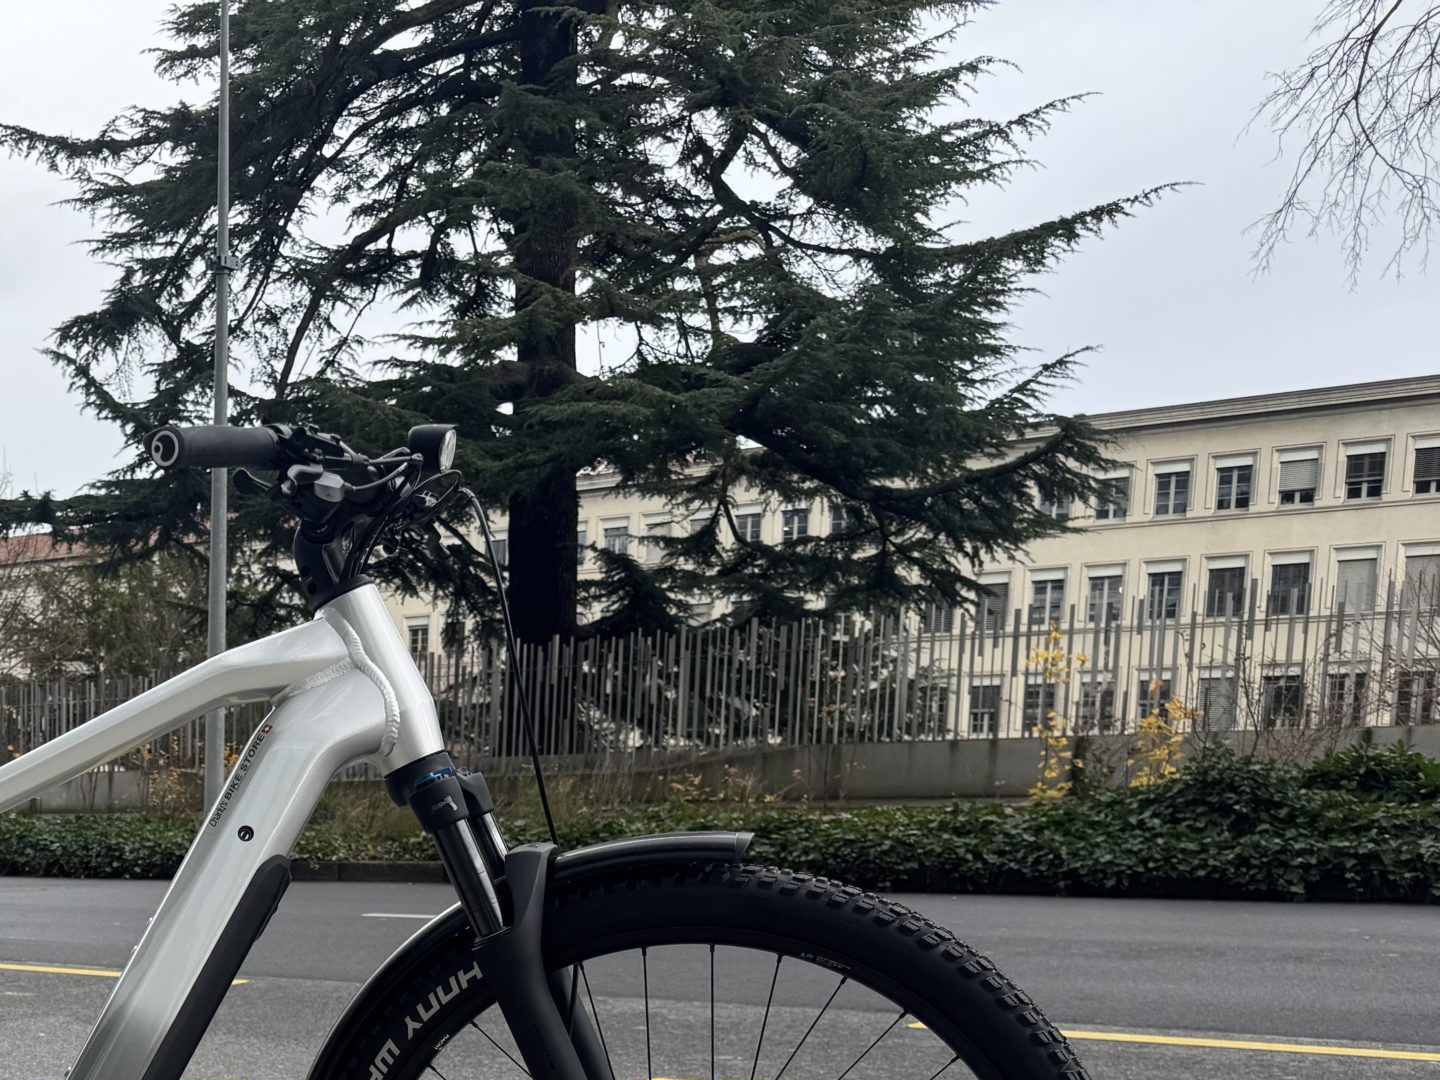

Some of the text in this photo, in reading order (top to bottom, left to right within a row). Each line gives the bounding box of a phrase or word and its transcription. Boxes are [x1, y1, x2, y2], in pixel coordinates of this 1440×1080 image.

[208, 734, 265, 828] Charly's BIKE STORE
[404, 961, 484, 1040] HNNY
